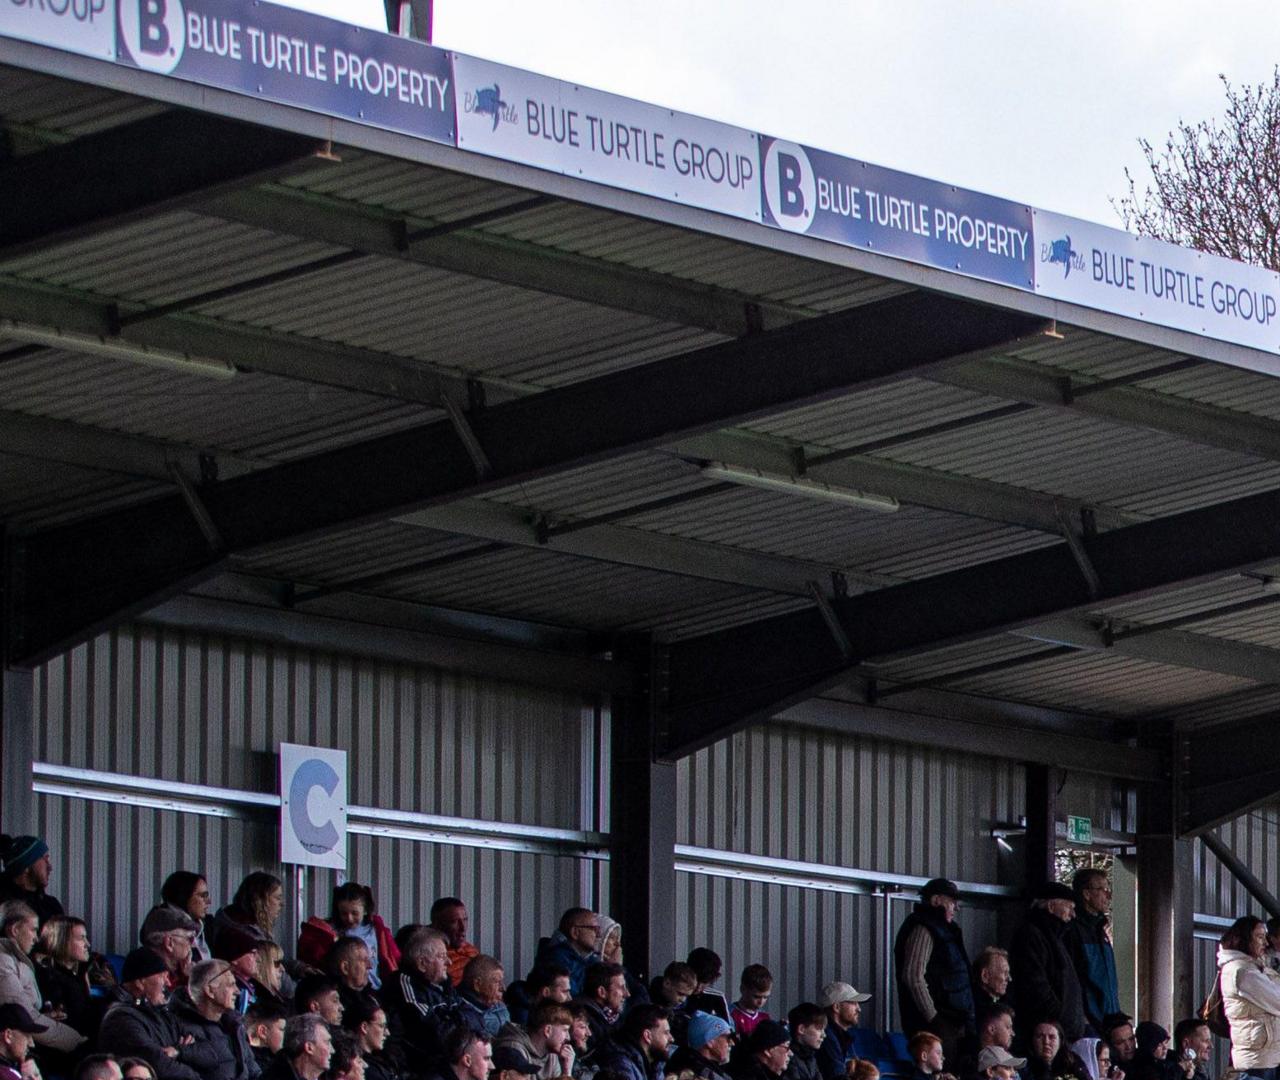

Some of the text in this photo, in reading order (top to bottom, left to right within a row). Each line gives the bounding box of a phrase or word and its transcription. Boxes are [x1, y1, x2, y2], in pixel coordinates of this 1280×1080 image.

[187, 11, 449, 113] BLUE TURTLE PROPERTY
[525, 98, 753, 190] BLUE TURTLE GROUP
[817, 177, 1029, 262] BLUE TURTLE PROPERTY
[1092, 248, 1277, 327] BLUE TURTLE GROUP
[289, 758, 340, 855] C
